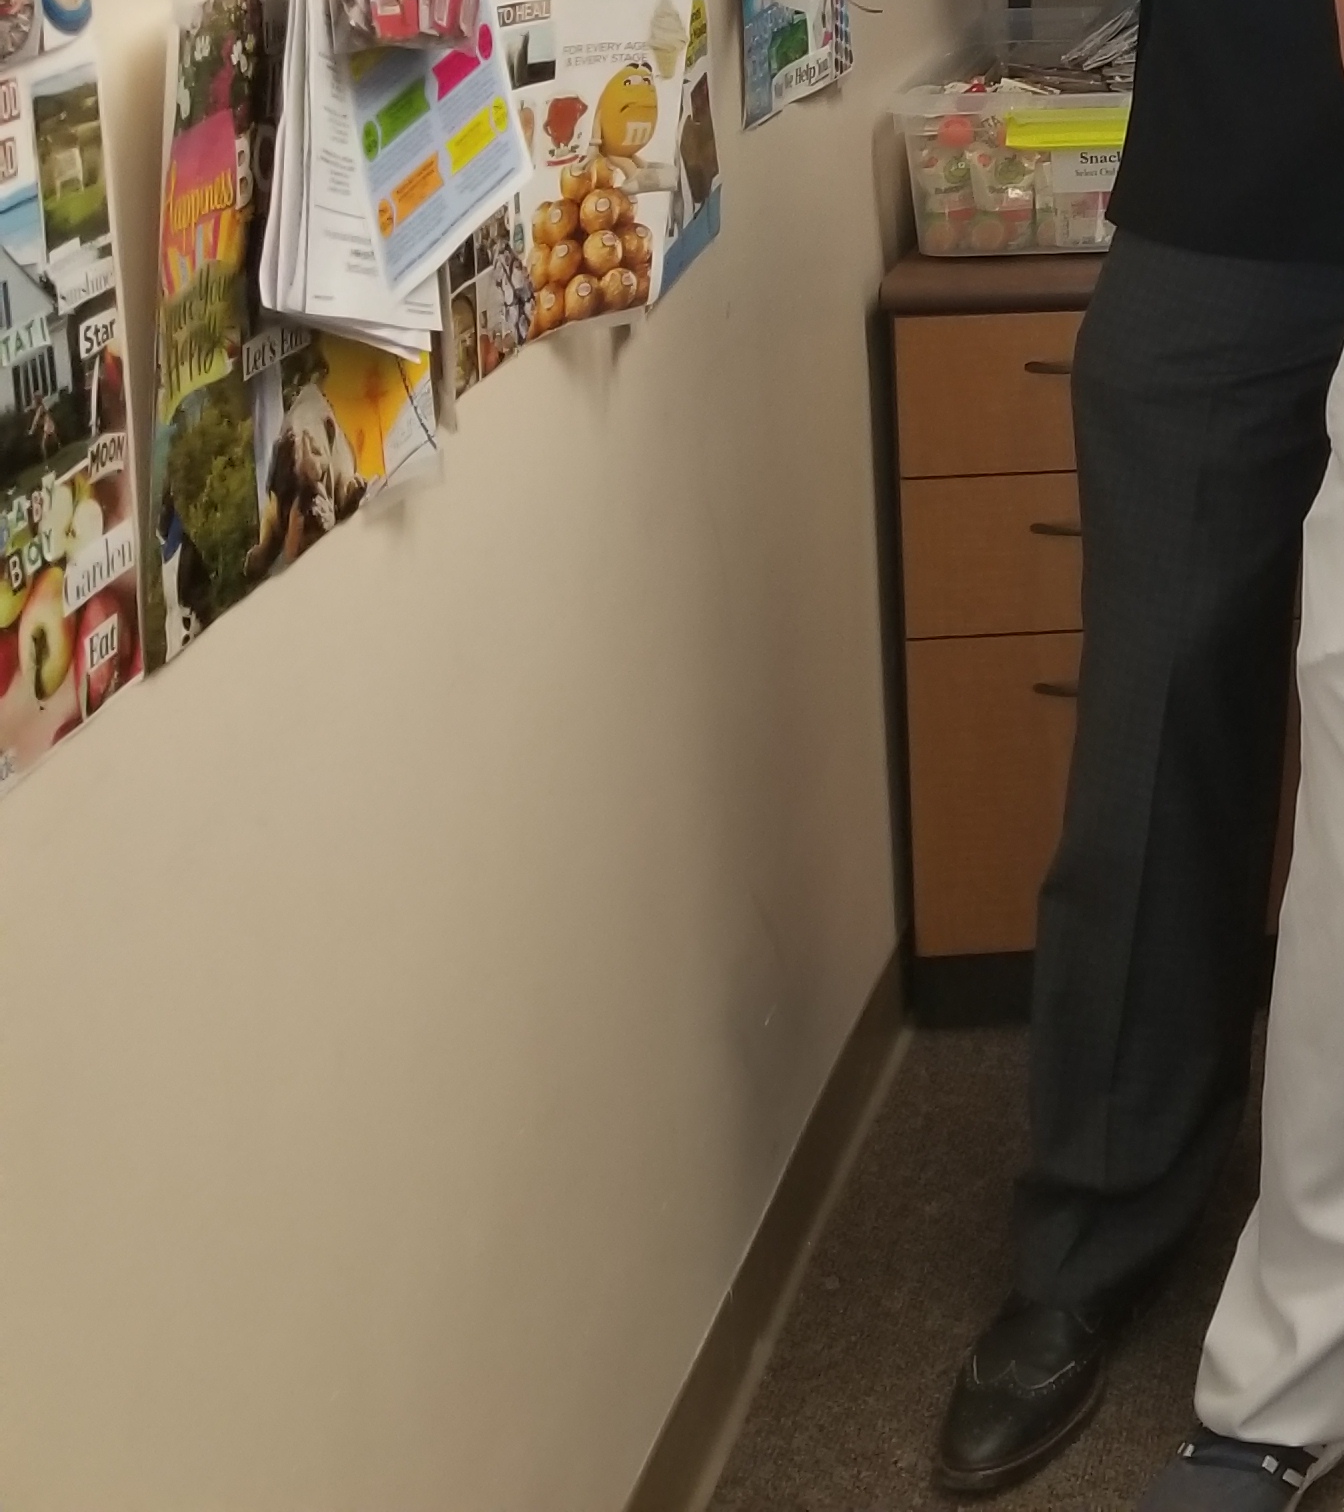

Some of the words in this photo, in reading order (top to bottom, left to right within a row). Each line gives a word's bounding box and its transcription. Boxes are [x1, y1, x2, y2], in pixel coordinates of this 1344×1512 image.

[516, 2, 551, 22] HEAL
[574, 54, 610, 66] EVERY
[611, 52, 649, 64] STAGE
[586, 41, 623, 53] EVERY
[795, 57, 817, 87] Help
[83, 318, 117, 355] Star
[244, 336, 277, 379] Let's
[89, 434, 126, 474] MOON
[63, 536, 133, 607] Garden
[88, 623, 117, 667] Eat
